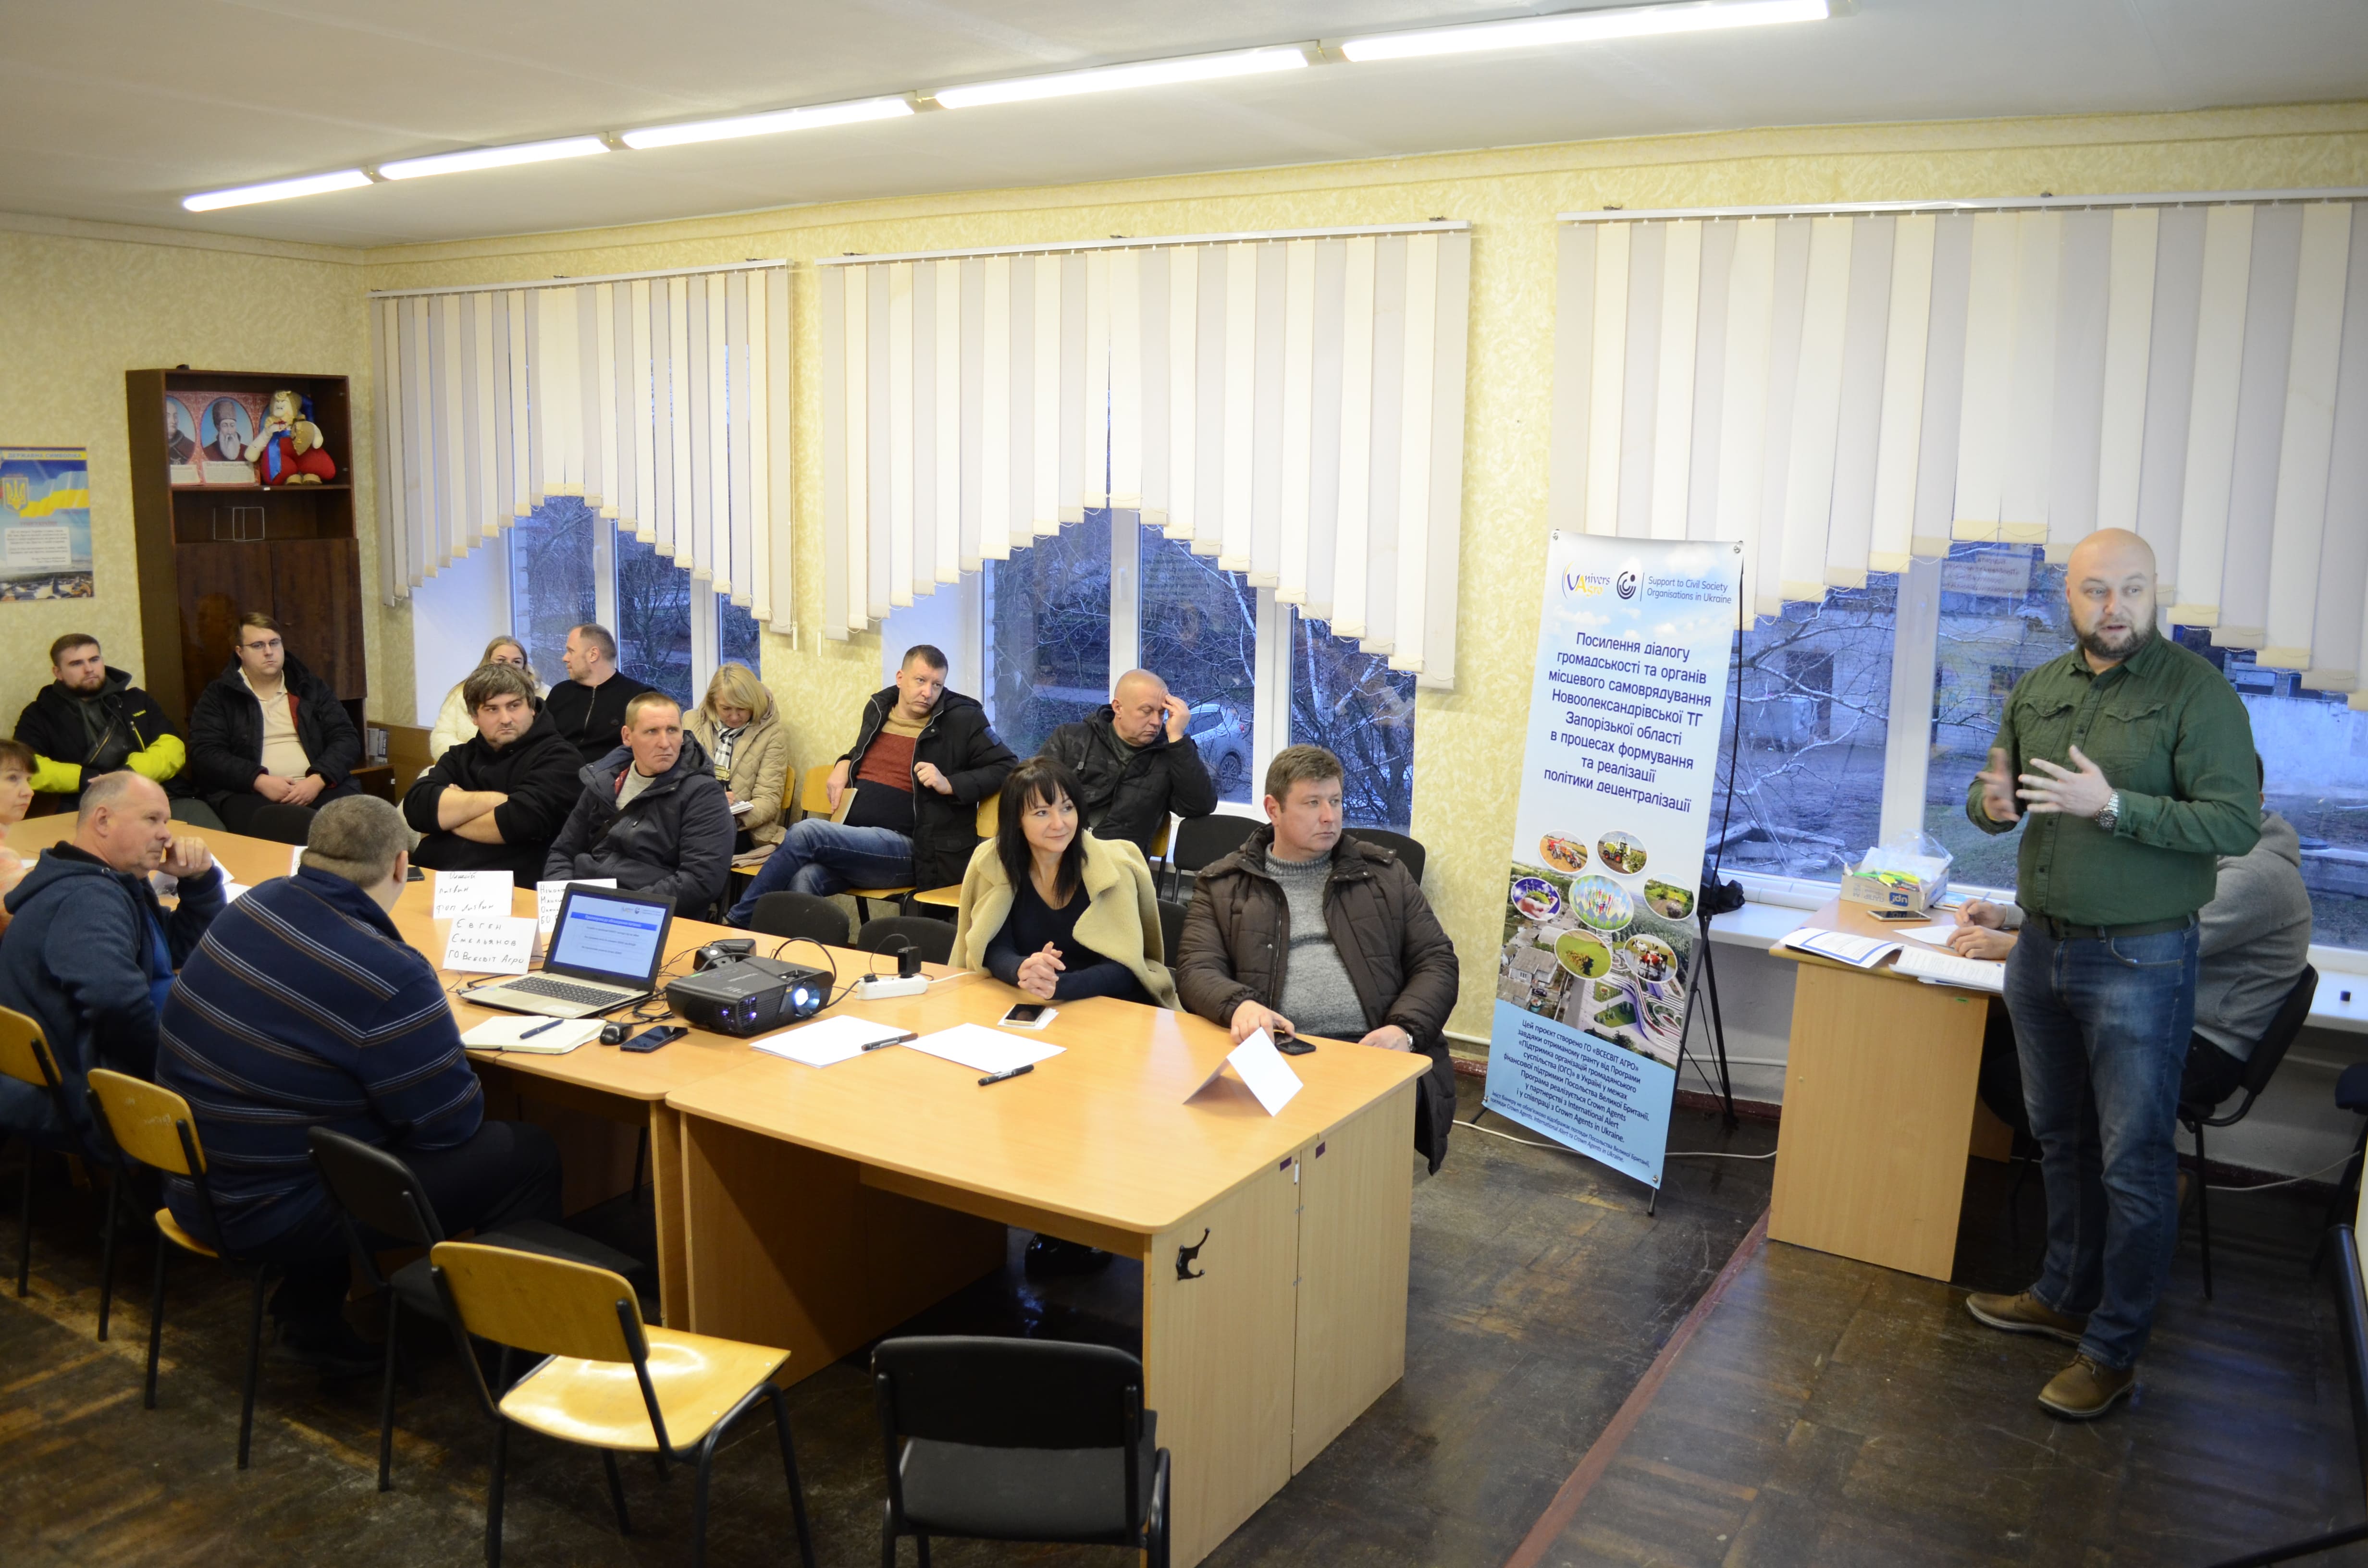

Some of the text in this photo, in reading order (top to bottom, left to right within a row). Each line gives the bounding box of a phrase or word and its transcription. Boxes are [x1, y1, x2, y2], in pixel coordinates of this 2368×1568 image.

[1647, 588, 1732, 604] Organisations in Ukraine
[1648, 576, 1728, 594] Support to Civil Society
[1576, 632, 1690, 663] Посилення діалогу
[1557, 652, 1707, 684] громадськості та органів
[1548, 669, 1712, 707] місцевого самоврядування
[1552, 688, 1703, 727] Новоолександрівської ТГ
[1566, 710, 1682, 746] Запорізької області
[1550, 731, 1694, 770] в процесах формування
[1581, 757, 1657, 783] та реалізації
[1544, 769, 1692, 813] політики децентралізації
[448, 949, 459, 958] ГО
[1522, 1019, 1534, 1030] Цей
[1535, 1026, 1556, 1037] проєкт
[1556, 1034, 1583, 1049] створено
[1583, 1043, 1592, 1052] ГО
[1517, 1029, 1641, 1084] завдяки отриманому гранту від Програми
[1554, 1054, 1588, 1072] організацій
[1588, 1068, 1637, 1093] громадянського
[1504, 1053, 1649, 1121] фінансової підтримки Посольства Великої Британії.
[1520, 1069, 1626, 1122] Програма реалізується Crown Agents
[1523, 1052, 1557, 1070] суспільства
[1580, 1074, 1602, 1089] Україні
[1607, 1087, 1628, 1101] межах
[1523, 1092, 1551, 1110] співпраці
[1555, 1105, 1573, 1119] Crown
[1573, 1114, 1594, 1128] Agents
[1594, 1122, 1600, 1132] in
[1601, 1126, 1625, 1143] Ukraine.
[1525, 1082, 1529, 1090] у
[1529, 1085, 1564, 1104] партнерстві
[1567, 1100, 1604, 1122] International
[1604, 1116, 1619, 1129] Alert
